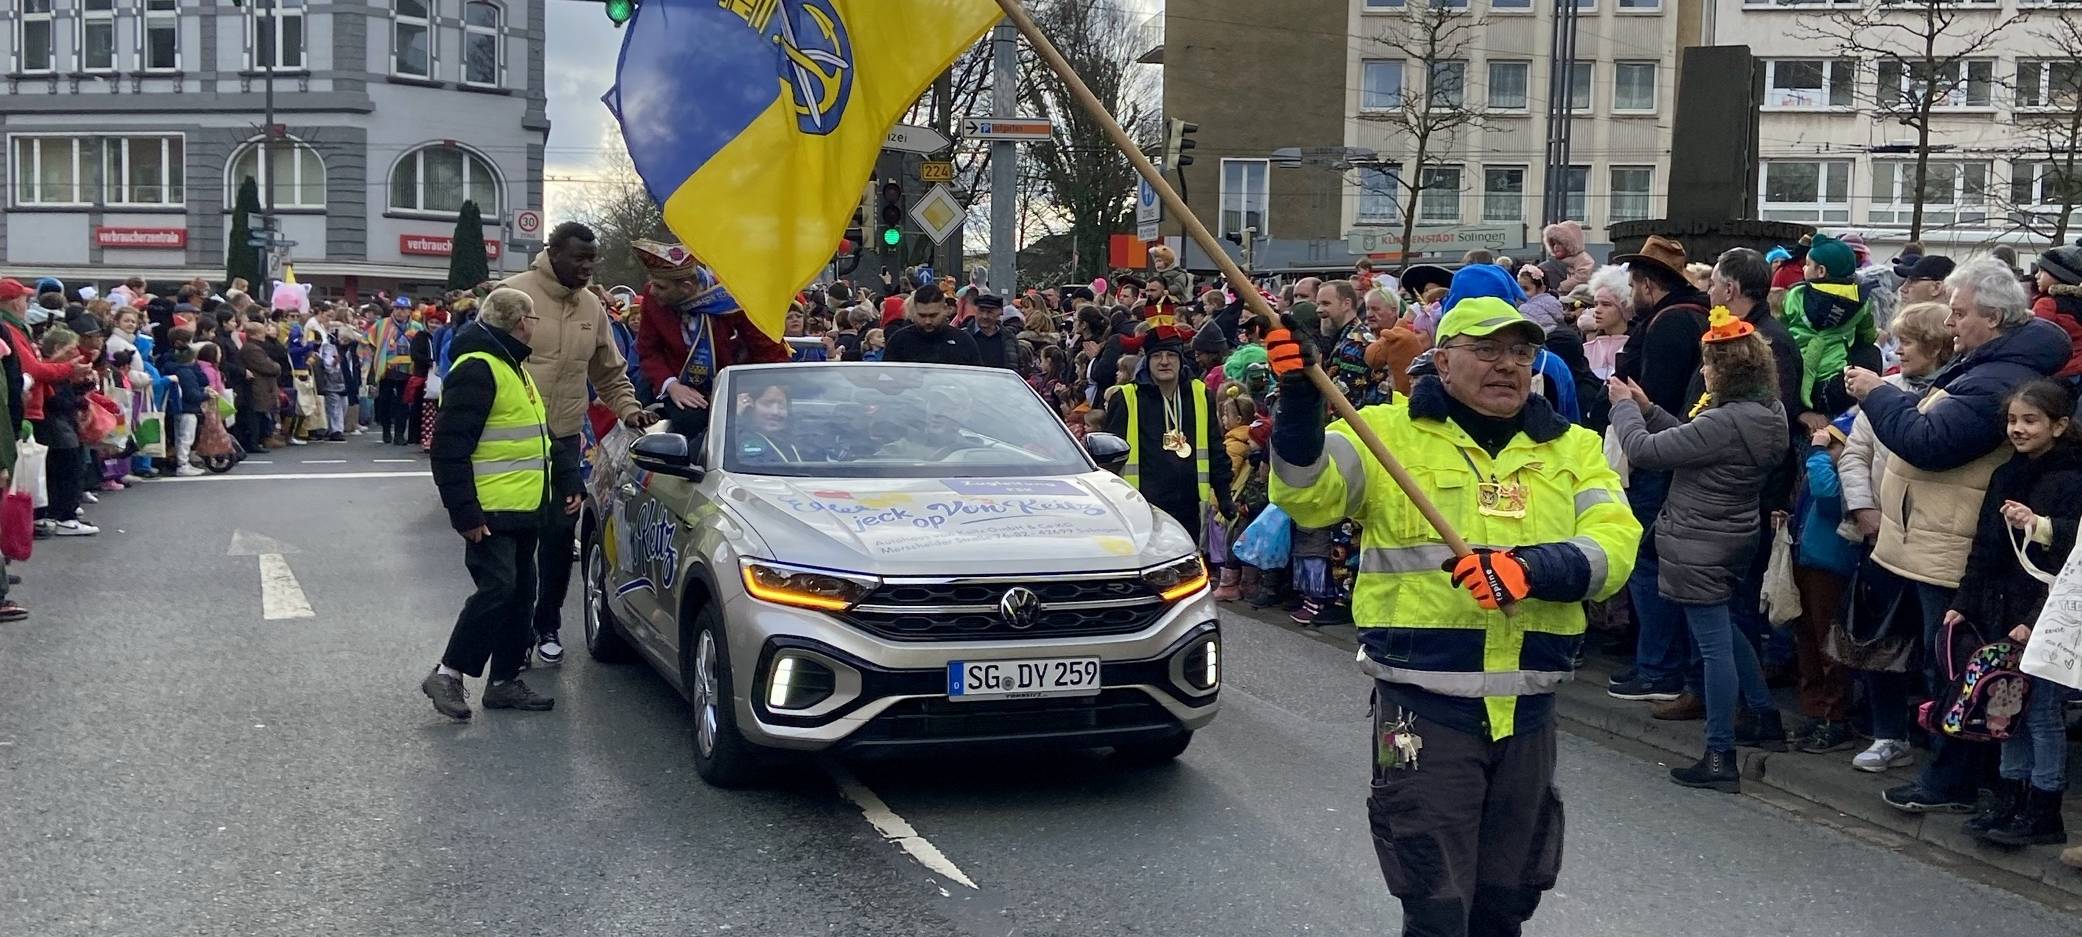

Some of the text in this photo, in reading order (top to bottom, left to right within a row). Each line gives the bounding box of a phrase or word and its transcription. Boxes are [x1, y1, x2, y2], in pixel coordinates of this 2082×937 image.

[925, 165, 949, 178] 224
[522, 216, 535, 228] 30
[1381, 231, 1506, 246] KLINENSTADT Solingen
[853, 506, 914, 533] jeck
[912, 513, 945, 529] op
[967, 664, 1001, 690] SG
[1017, 662, 1049, 689] DY
[1054, 660, 1098, 687] 259
